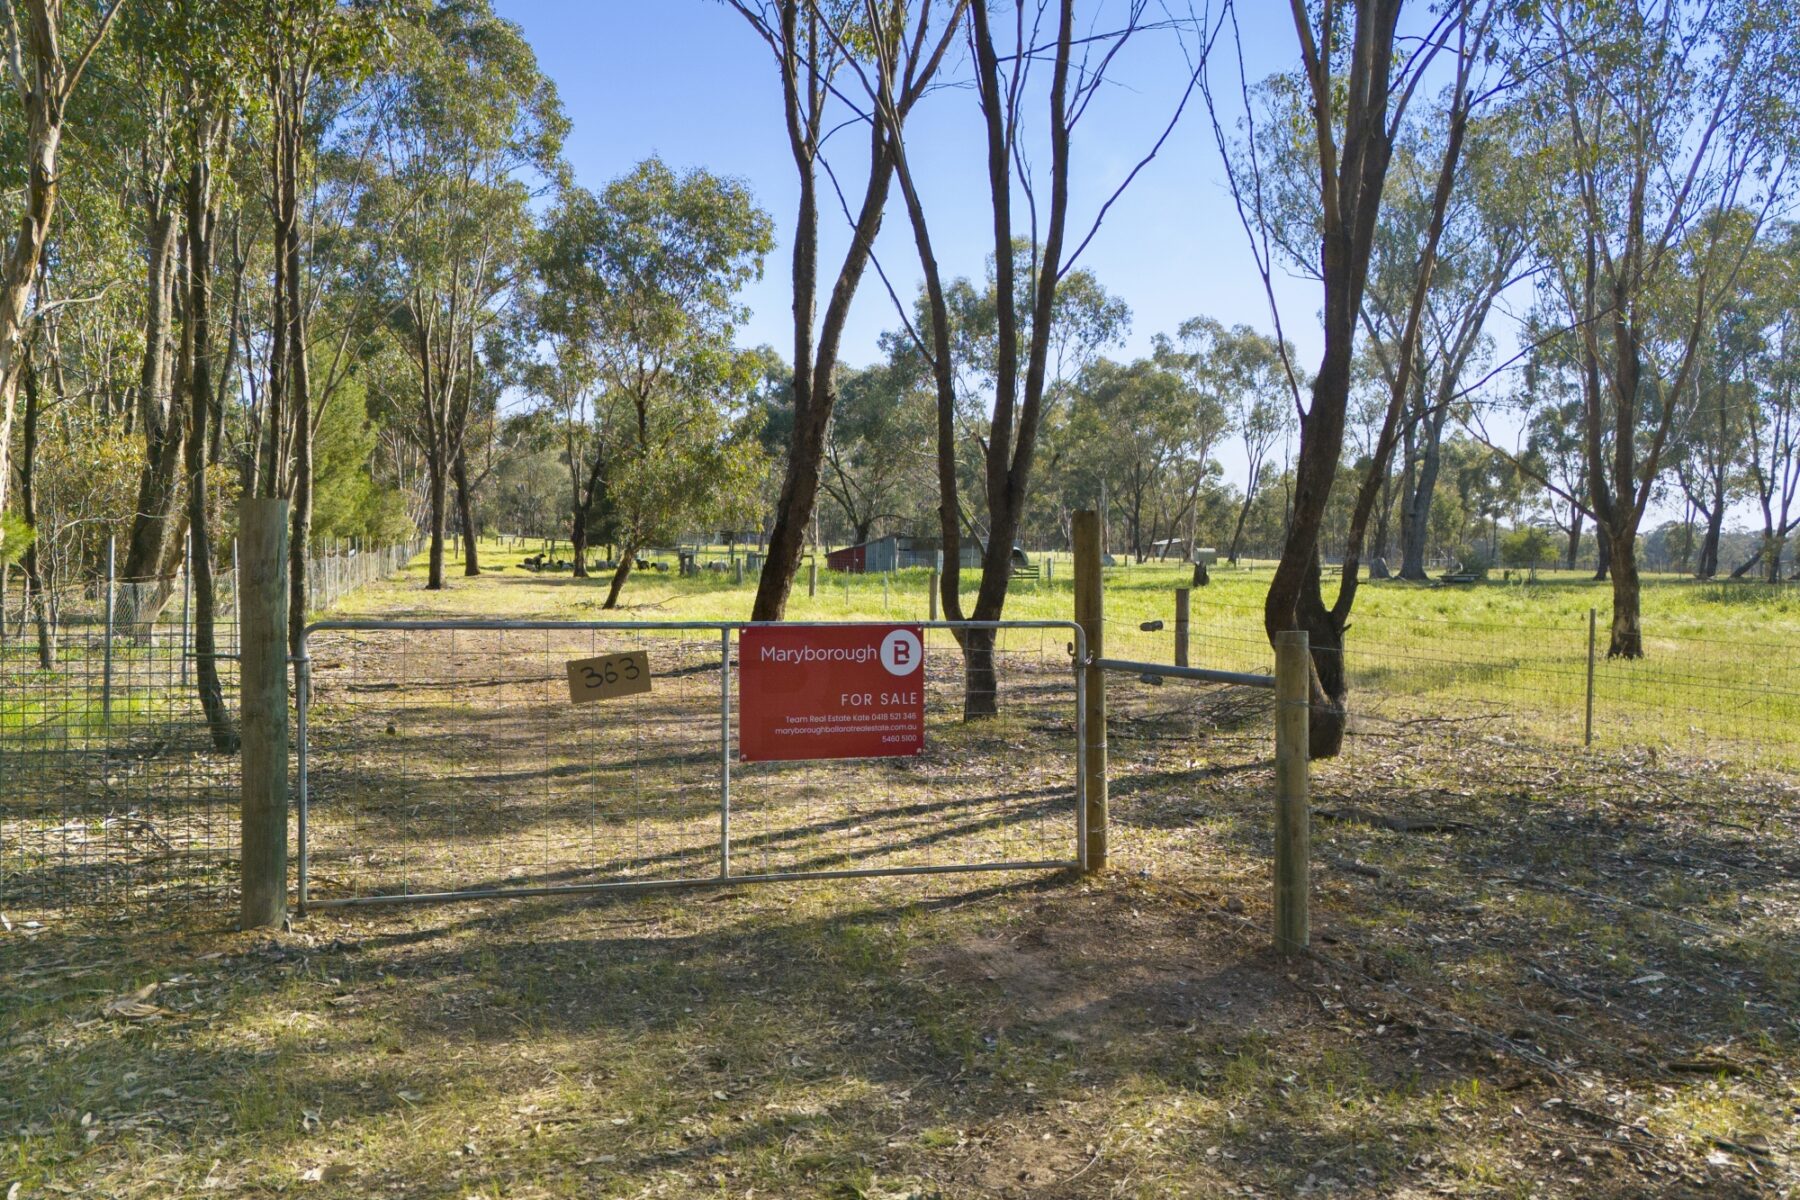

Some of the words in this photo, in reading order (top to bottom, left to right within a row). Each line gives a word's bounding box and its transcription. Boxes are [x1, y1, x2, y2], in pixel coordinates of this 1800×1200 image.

[761, 644, 877, 664] Maryborough
[893, 640, 910, 665] B
[580, 657, 640, 688] 363
[841, 693, 872, 706] FOR
[880, 692, 917, 705] SALE
[785, 715, 808, 723] Team
[828, 714, 851, 722] Estate
